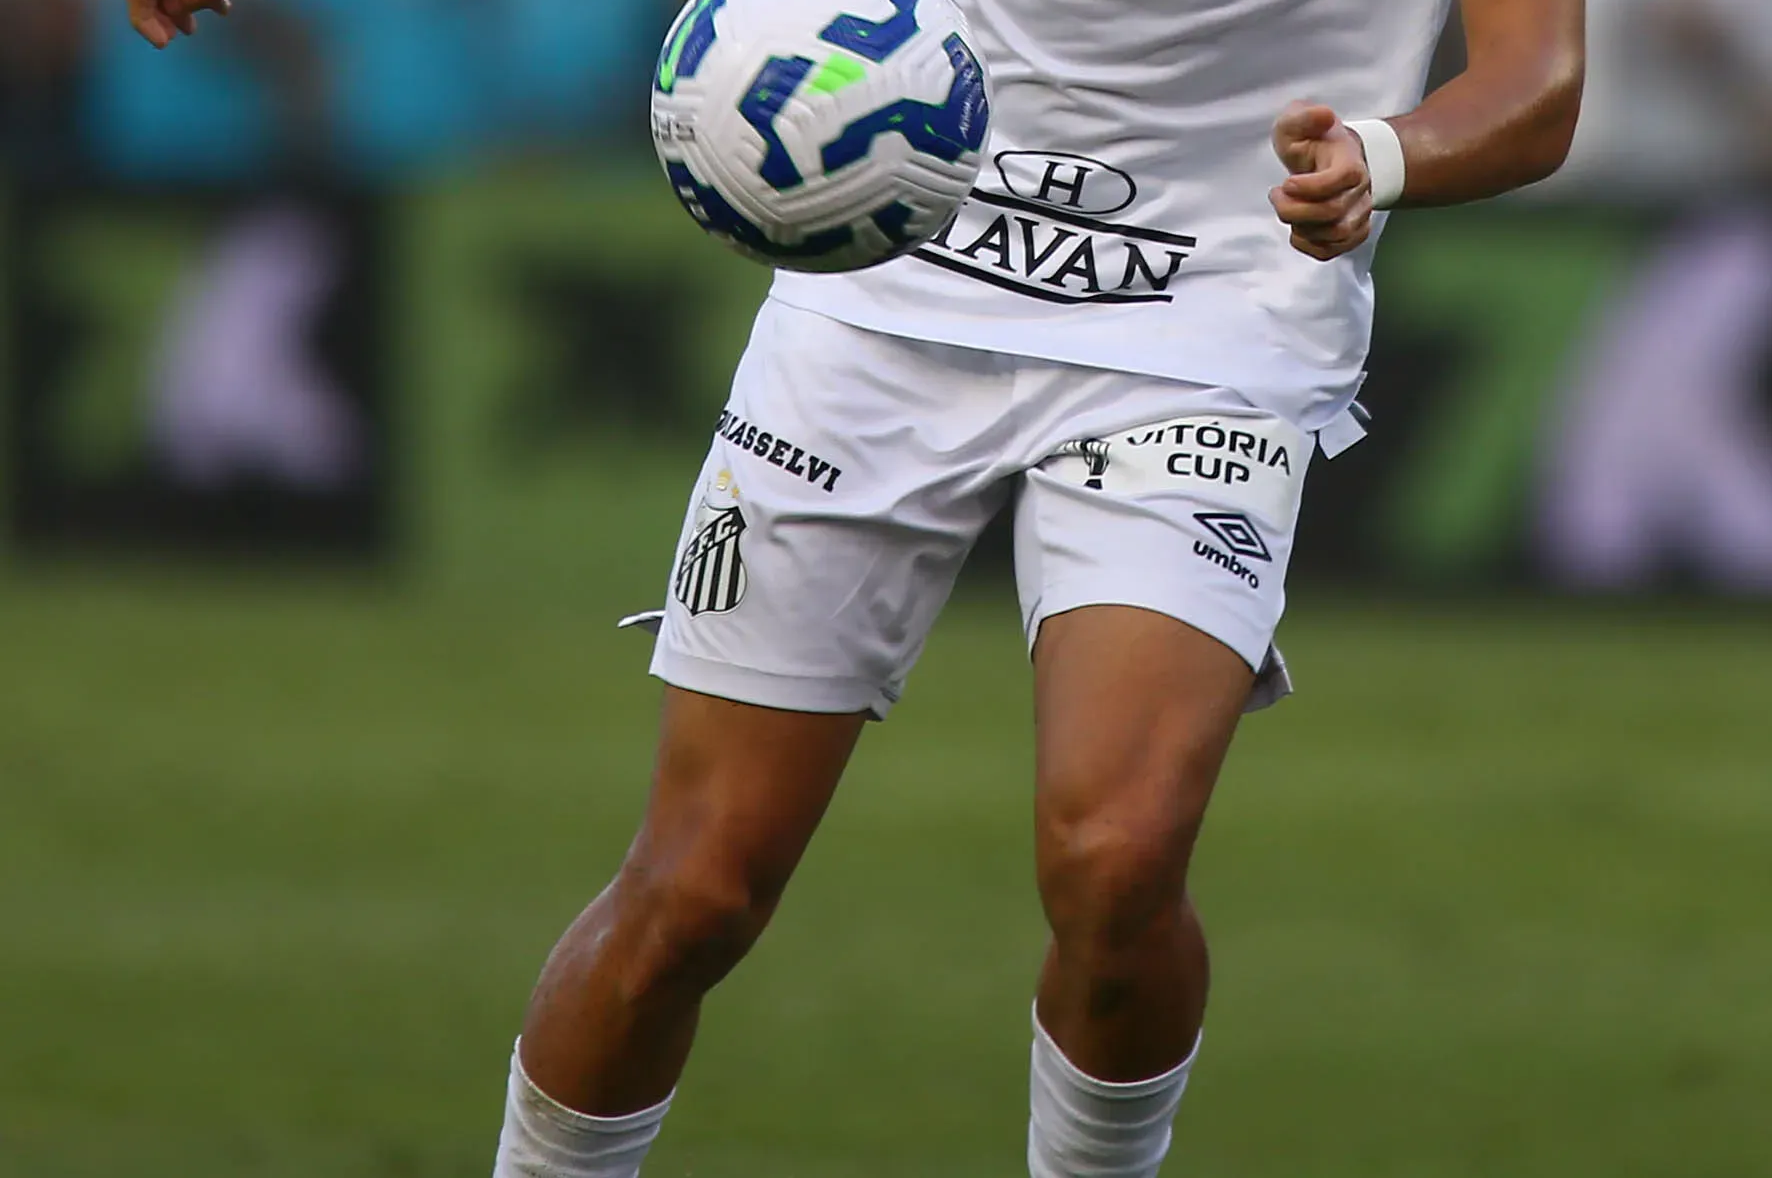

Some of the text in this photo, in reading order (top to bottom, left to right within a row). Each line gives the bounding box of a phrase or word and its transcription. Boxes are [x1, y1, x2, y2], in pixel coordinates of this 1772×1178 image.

[1031, 160, 1093, 209] H
[1166, 452, 1250, 485] CUP
[1193, 540, 1260, 590] umbro
